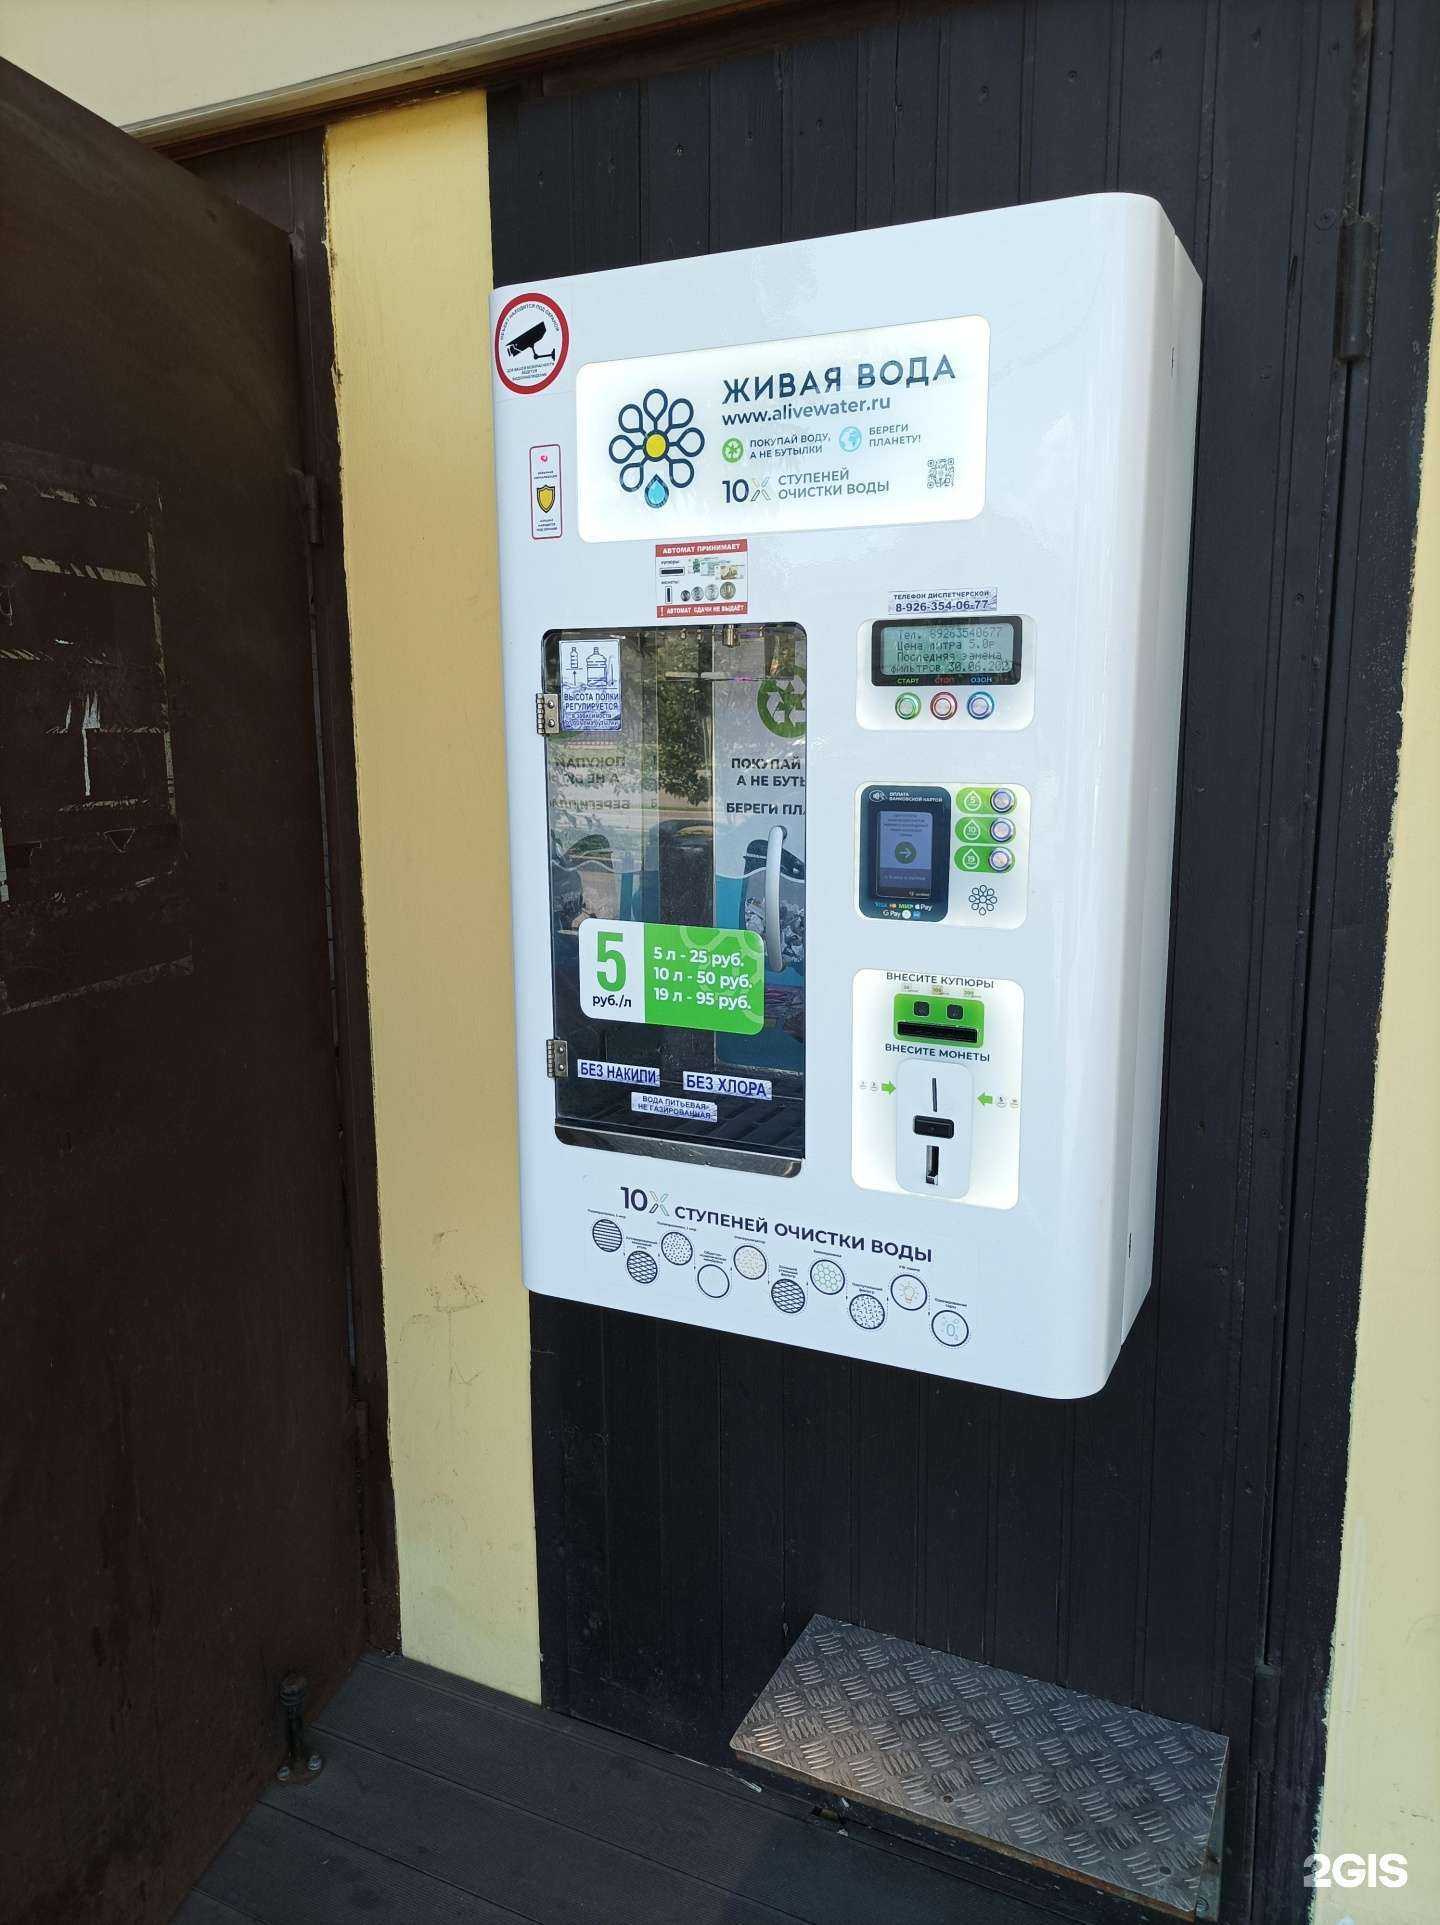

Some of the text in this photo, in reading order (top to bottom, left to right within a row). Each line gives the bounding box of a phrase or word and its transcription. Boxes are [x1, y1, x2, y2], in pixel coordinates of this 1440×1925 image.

[722, 354, 956, 404] ЖИВАЯ ВОДА
[722, 397, 891, 426] www.alivewater.ru
[869, 424, 909, 435] БЕРЕГИ
[750, 433, 831, 448] ПОКУПАЙ ВОДУ,
[869, 434, 921, 448] ПЛАНЕТУ!
[750, 446, 823, 459] А НЕ БУТЫЛКИ
[778, 466, 850, 486] СТУПЕНЕЙ
[778, 480, 890, 500] ОЧИСТКИ ВОДЫ
[662, 543, 741, 555] АВТОМАТ ПРИНИМАЕТ
[928, 590, 990, 599] ДИСПЕТЧЕРСКОЙ
[666, 607, 691, 615] АВТОМАТ
[896, 600, 989, 613] 8-926-354-06-77
[897, 640, 923, 651] Цена
[897, 677, 920, 685] СТАРТ
[970, 675, 993, 684] ОЗОН
[564, 693, 618, 701] ВЫСОТА ПОЛКИ
[565, 702, 618, 711] РЕГУЛИРУЕТСЯ
[736, 775, 747, 786] А
[750, 775, 769, 786] НЕ
[726, 802, 778, 815] БЕРЕГИ
[596, 930, 627, 993] 5
[653, 946, 663, 961] 5
[666, 949, 676, 961] л
[690, 949, 708, 964] 25
[711, 952, 744, 968] руб.
[653, 967, 670, 981] 10
[673, 971, 683, 982] л
[696, 971, 716, 985] 50
[720, 973, 753, 989] руб.
[886, 972, 994, 989] ВНЕСИТЕ КУПЮРЫ
[592, 994, 632, 1009] руб./л
[653, 987, 670, 1001] 19
[672, 991, 683, 1003] л
[696, 991, 715, 1006] 95
[718, 993, 752, 1010] руб.
[885, 1042, 991, 1062] ВНЕСИТЕ МОНЕТЫ
[580, 1061, 657, 1084] БЕЗ НАКИПИ
[686, 1074, 768, 1097] БЕЗ ХЛОРА
[642, 1095, 663, 1104] ВОДА
[674, 1206, 768, 1234] СТУПЕНЕЙ
[774, 1223, 865, 1250] ОЧИСТКИ
[871, 1239, 933, 1263] ВОДЫ
